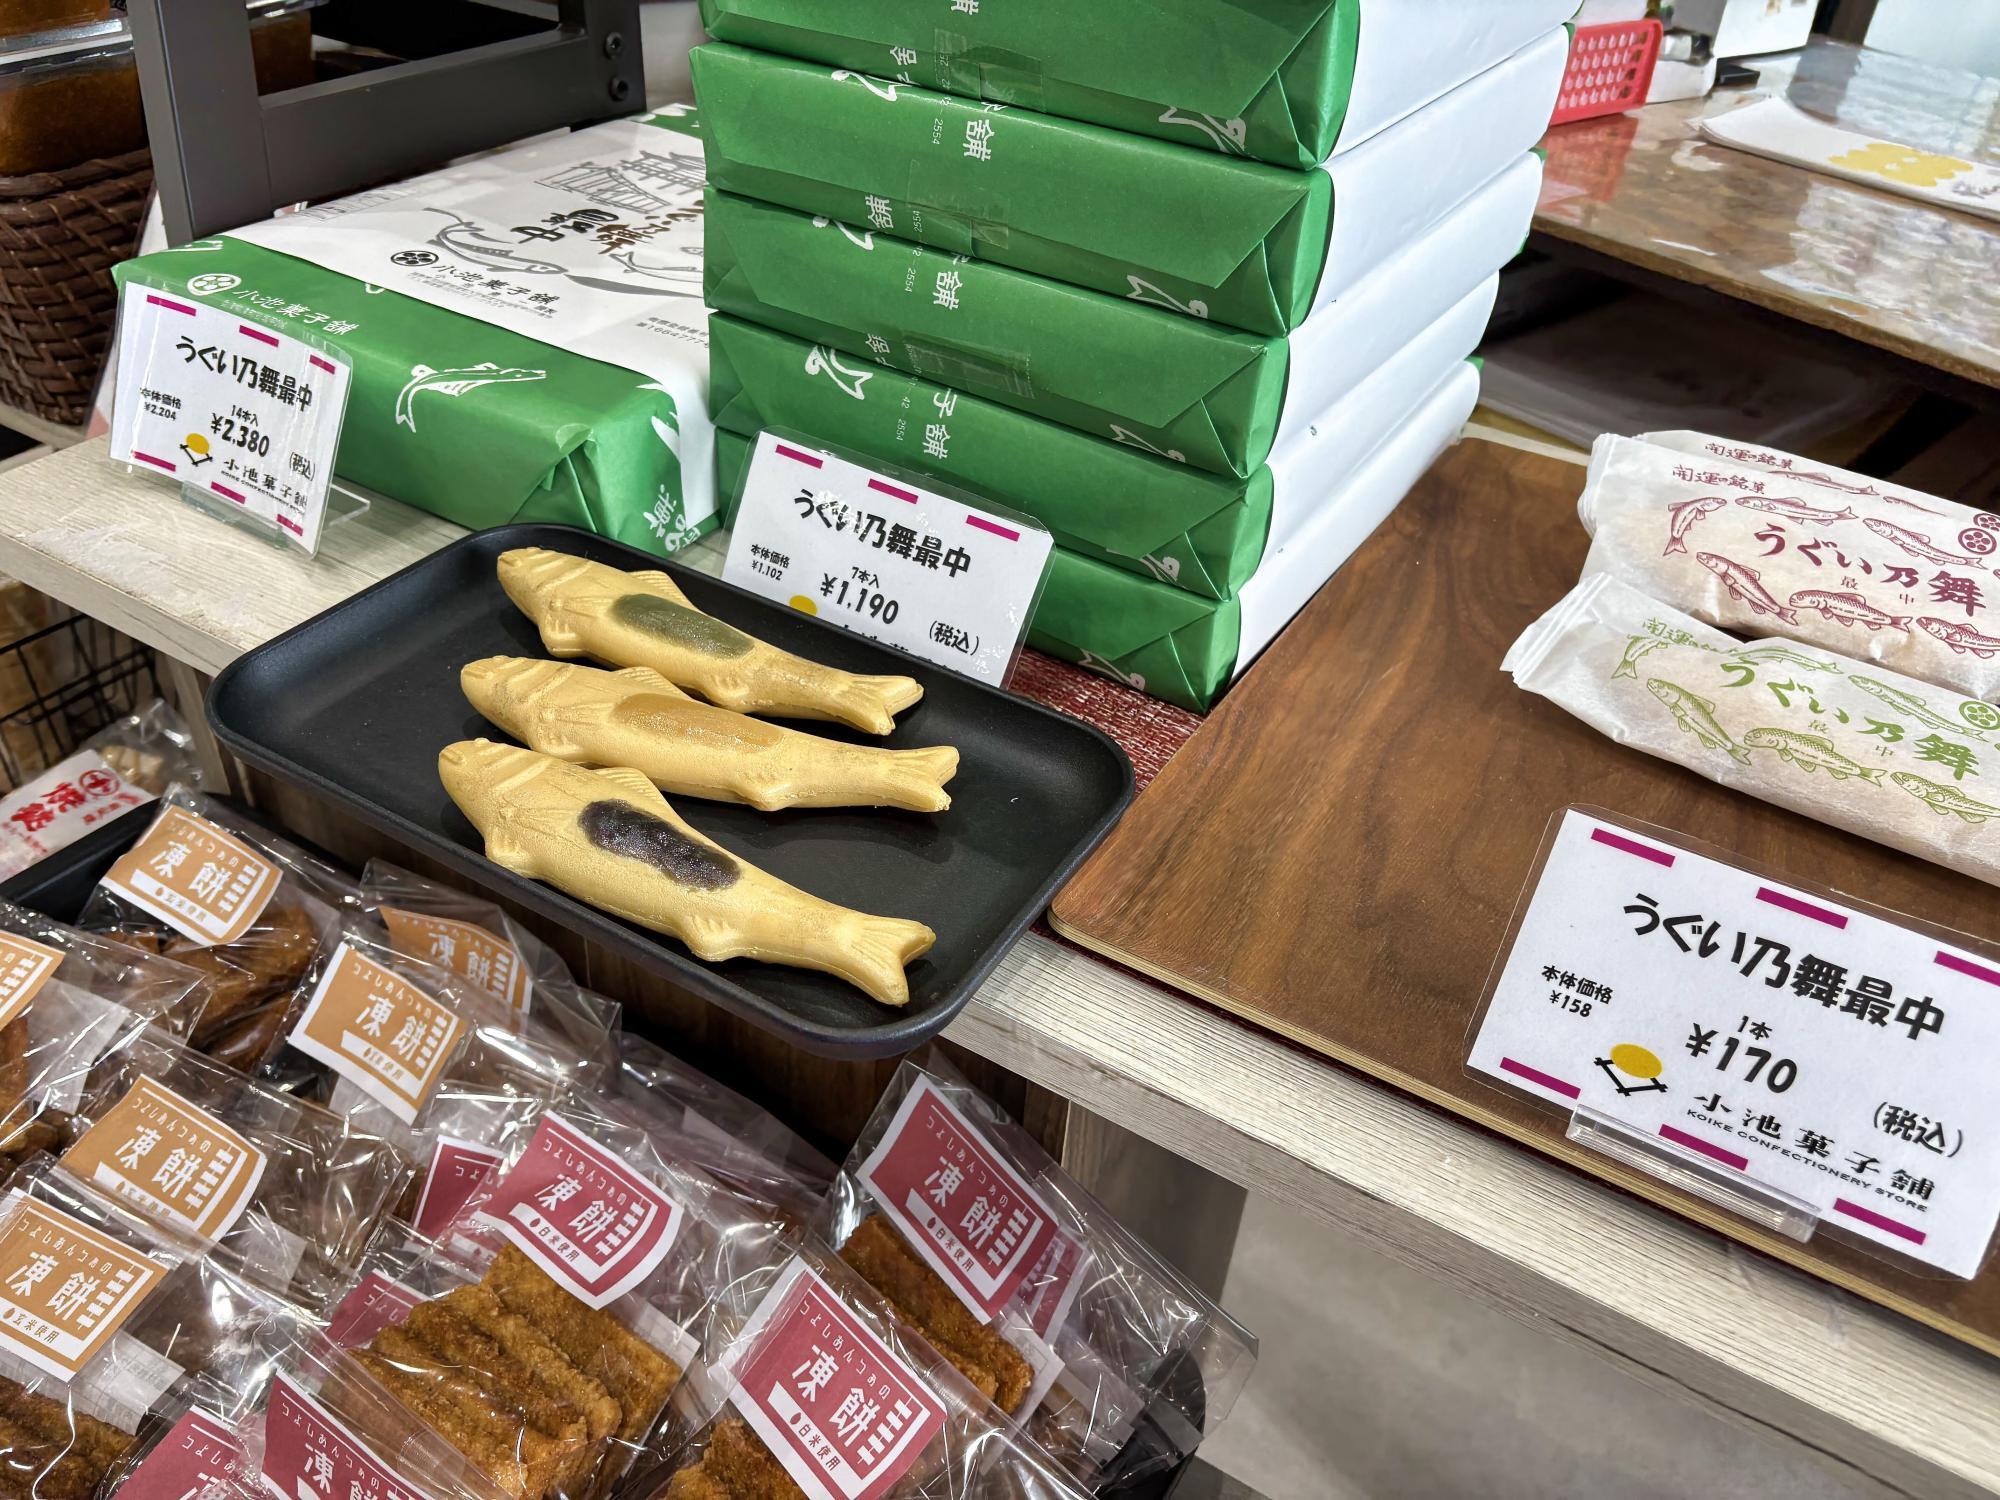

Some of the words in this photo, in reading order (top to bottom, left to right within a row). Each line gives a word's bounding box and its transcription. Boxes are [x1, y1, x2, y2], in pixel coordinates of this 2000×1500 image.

[175, 335, 313, 412] うぐい乃舞最中
[231, 404, 259, 427] 14本入
[750, 544, 790, 569] 本体価格
[794, 488, 972, 578] うぐい乃舞最中
[820, 573, 899, 625] ¥1,190
[851, 566, 880, 589] 7本入
[1753, 523, 1988, 617] うぐい乃舞
[929, 620, 980, 656] (税込)
[1720, 658, 1980, 780] うぐい乃舞
[150, 840, 233, 904] 凍餅
[1541, 964, 1615, 1006] 本体価格
[1623, 892, 1946, 1041] うぐい乃舞最中
[355, 993, 427, 1061] 凍餅
[1549, 990, 1593, 1018] ¥158
[1737, 1015, 1773, 1042] 1本
[1685, 1022, 1798, 1093] ¥170
[114, 1124, 202, 1198] 凍餅
[1687, 1109, 1733, 1132] KOIKE
[1737, 1130, 1872, 1189] CONFECTIONERY
[1875, 1187, 1928, 1213] STORE
[1693, 1093, 1936, 1201] 小池菓子舗
[1873, 1101, 1964, 1158] (税込)
[534, 1174, 619, 1243] 凍餅
[924, 1156, 1003, 1250] 凍餅
[537, 1226, 580, 1263] 白米使用
[935, 1227, 975, 1273] 白米使用
[5, 1251, 102, 1320] 凍餅
[13, 1312, 60, 1343] 玄米使用
[791, 1344, 882, 1448] 凍餅
[797, 1423, 842, 1472] 白米使用
